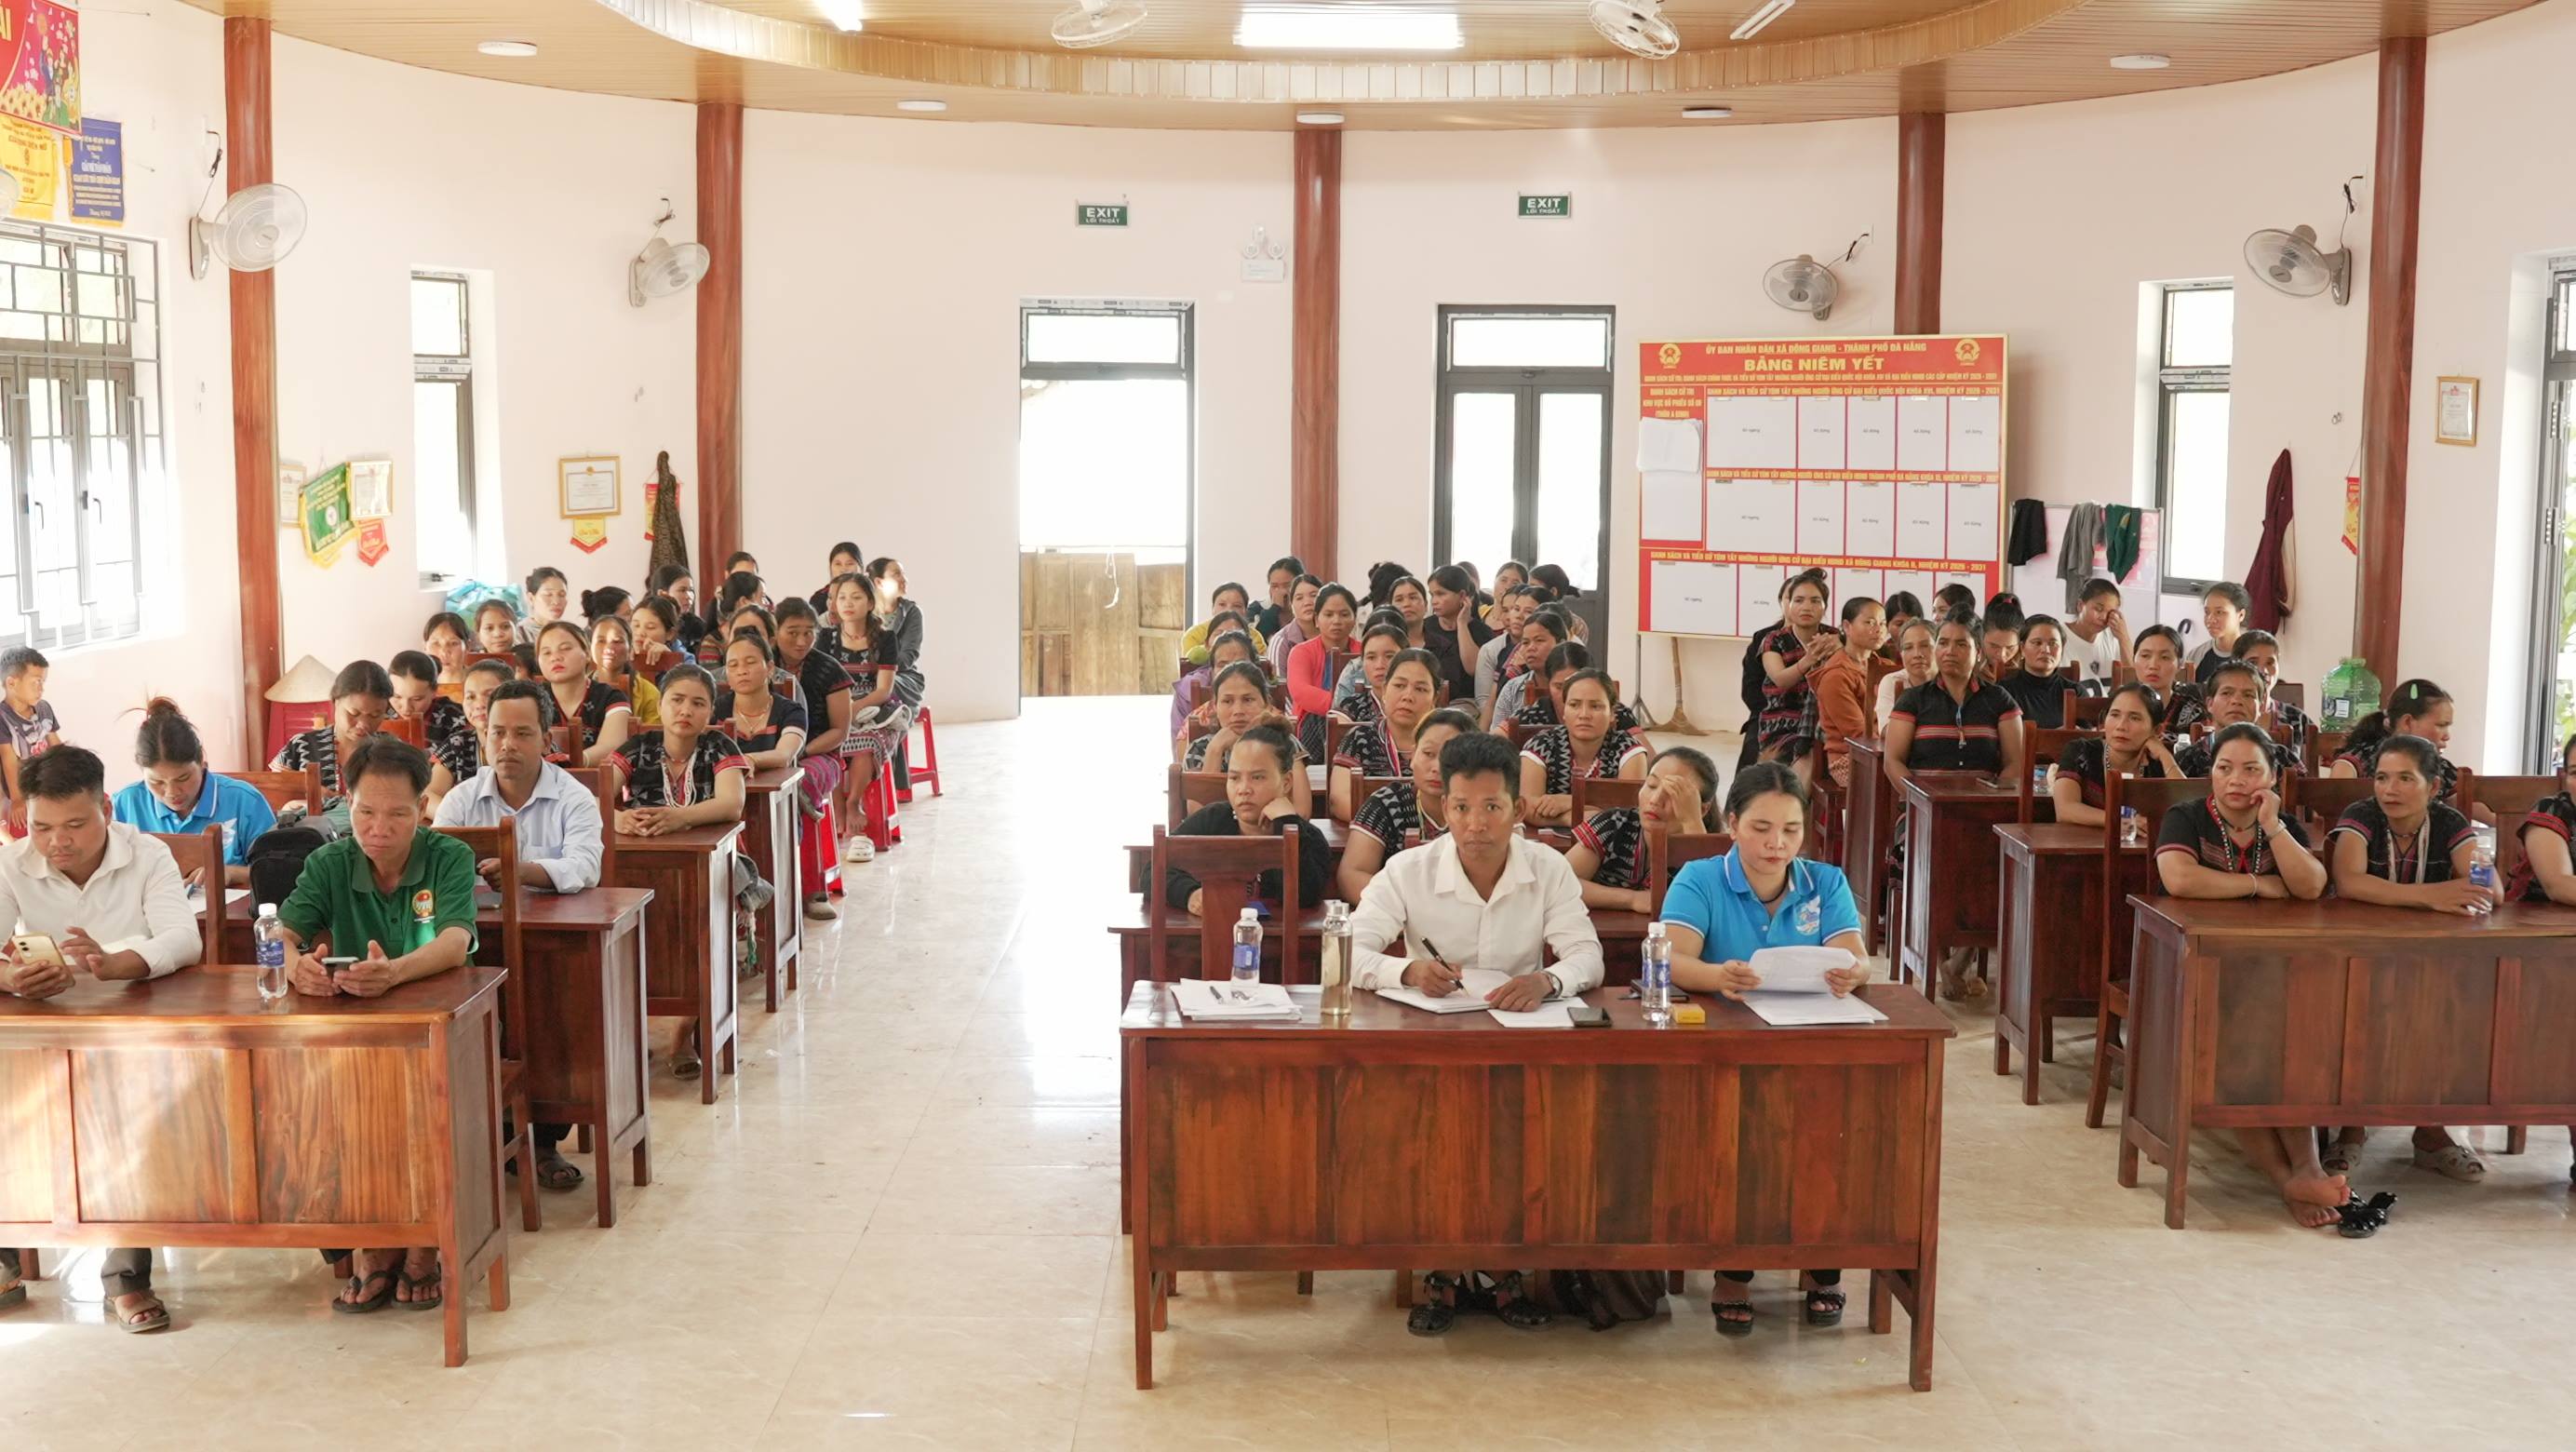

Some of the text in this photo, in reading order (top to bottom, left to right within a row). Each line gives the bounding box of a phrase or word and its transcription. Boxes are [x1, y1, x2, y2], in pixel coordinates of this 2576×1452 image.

[1527, 197, 1561, 208] EXIT
[1086, 207, 1120, 218] EXIT
[1745, 355, 1885, 371] BẢNG NIÊM YẾT
